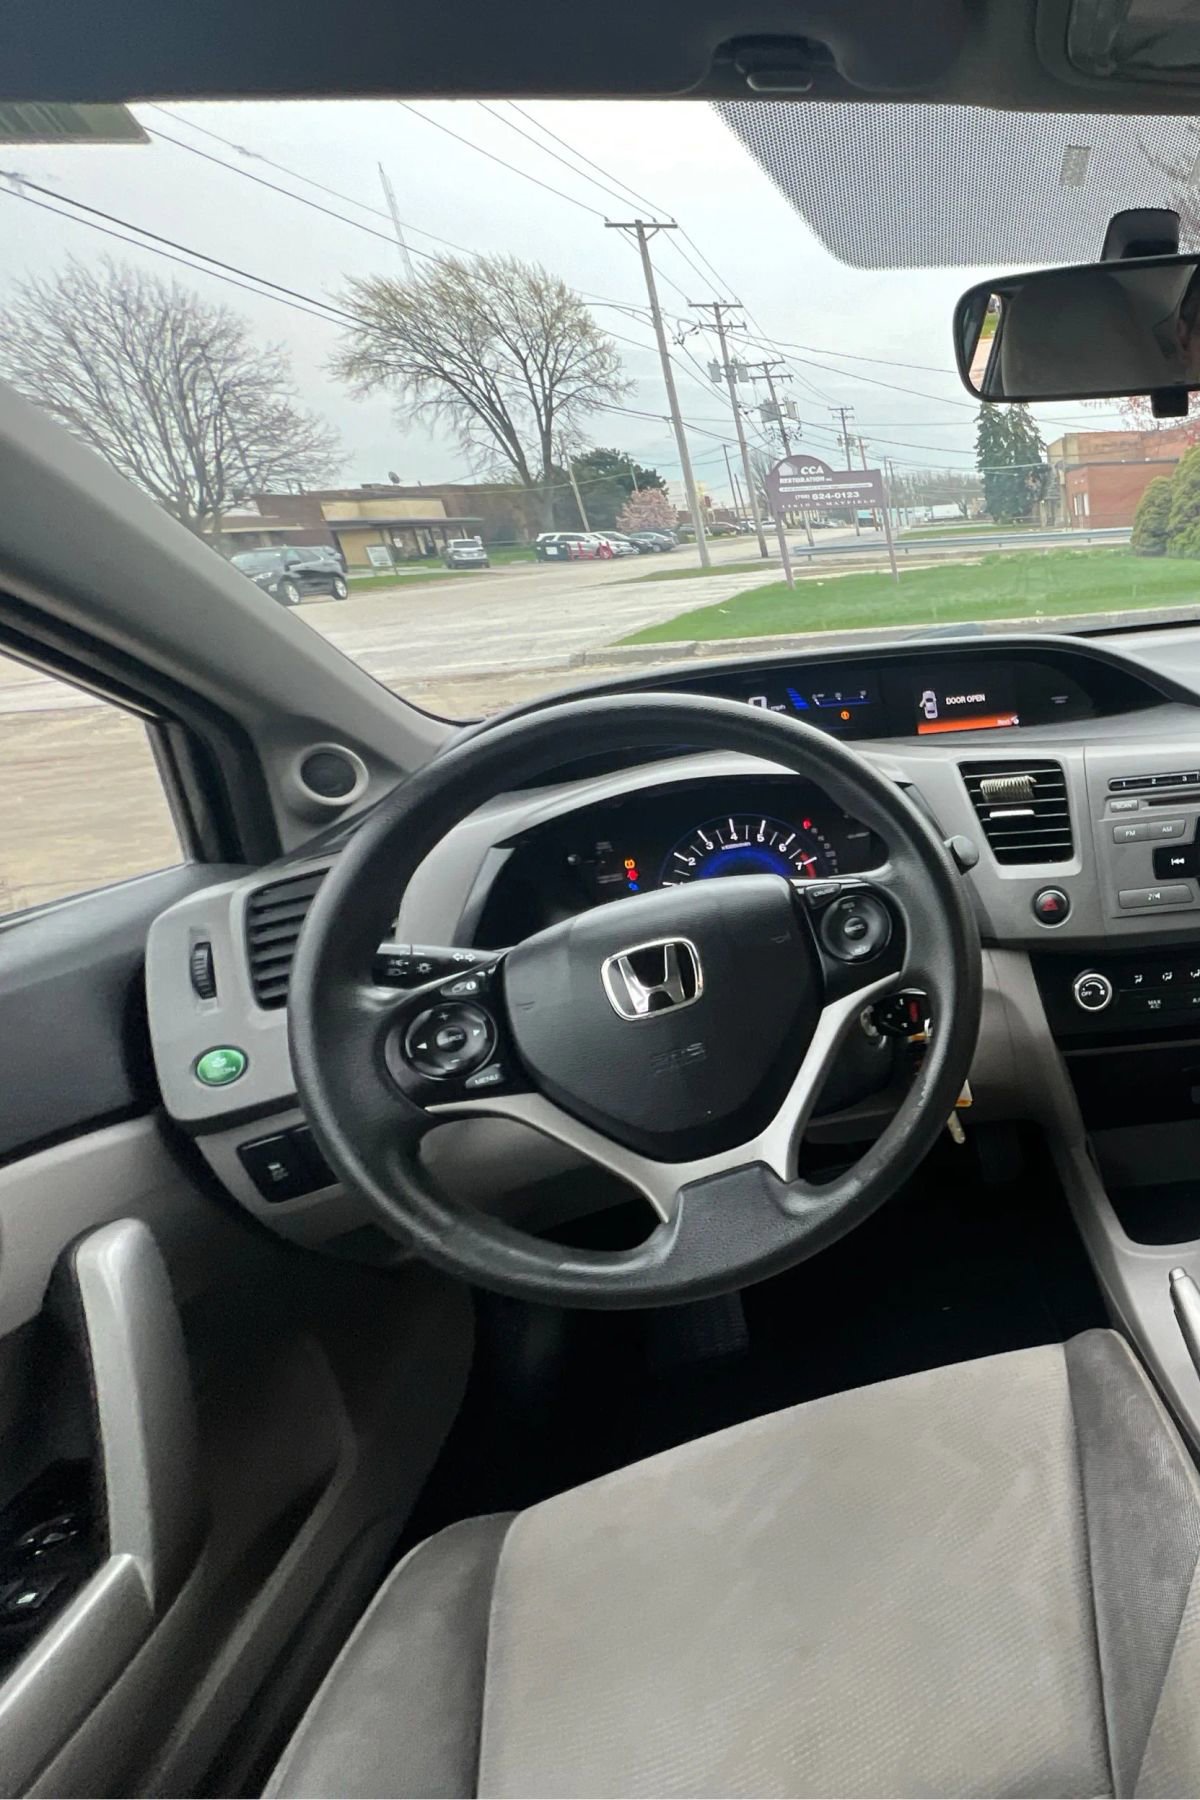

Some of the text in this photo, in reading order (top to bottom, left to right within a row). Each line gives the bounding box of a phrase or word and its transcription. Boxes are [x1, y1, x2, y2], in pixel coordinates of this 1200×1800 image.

[801, 466, 824, 475] CCA
[945, 694, 986, 705] DOOR OPEN
[730, 832, 739, 841] 4
[757, 833, 765, 842] 5
[706, 841, 714, 850] 3
[778, 844, 787, 852] 6
[687, 857, 696, 866] 2
[795, 862, 803, 870] 7
[474, 1074, 499, 1085] MENU
